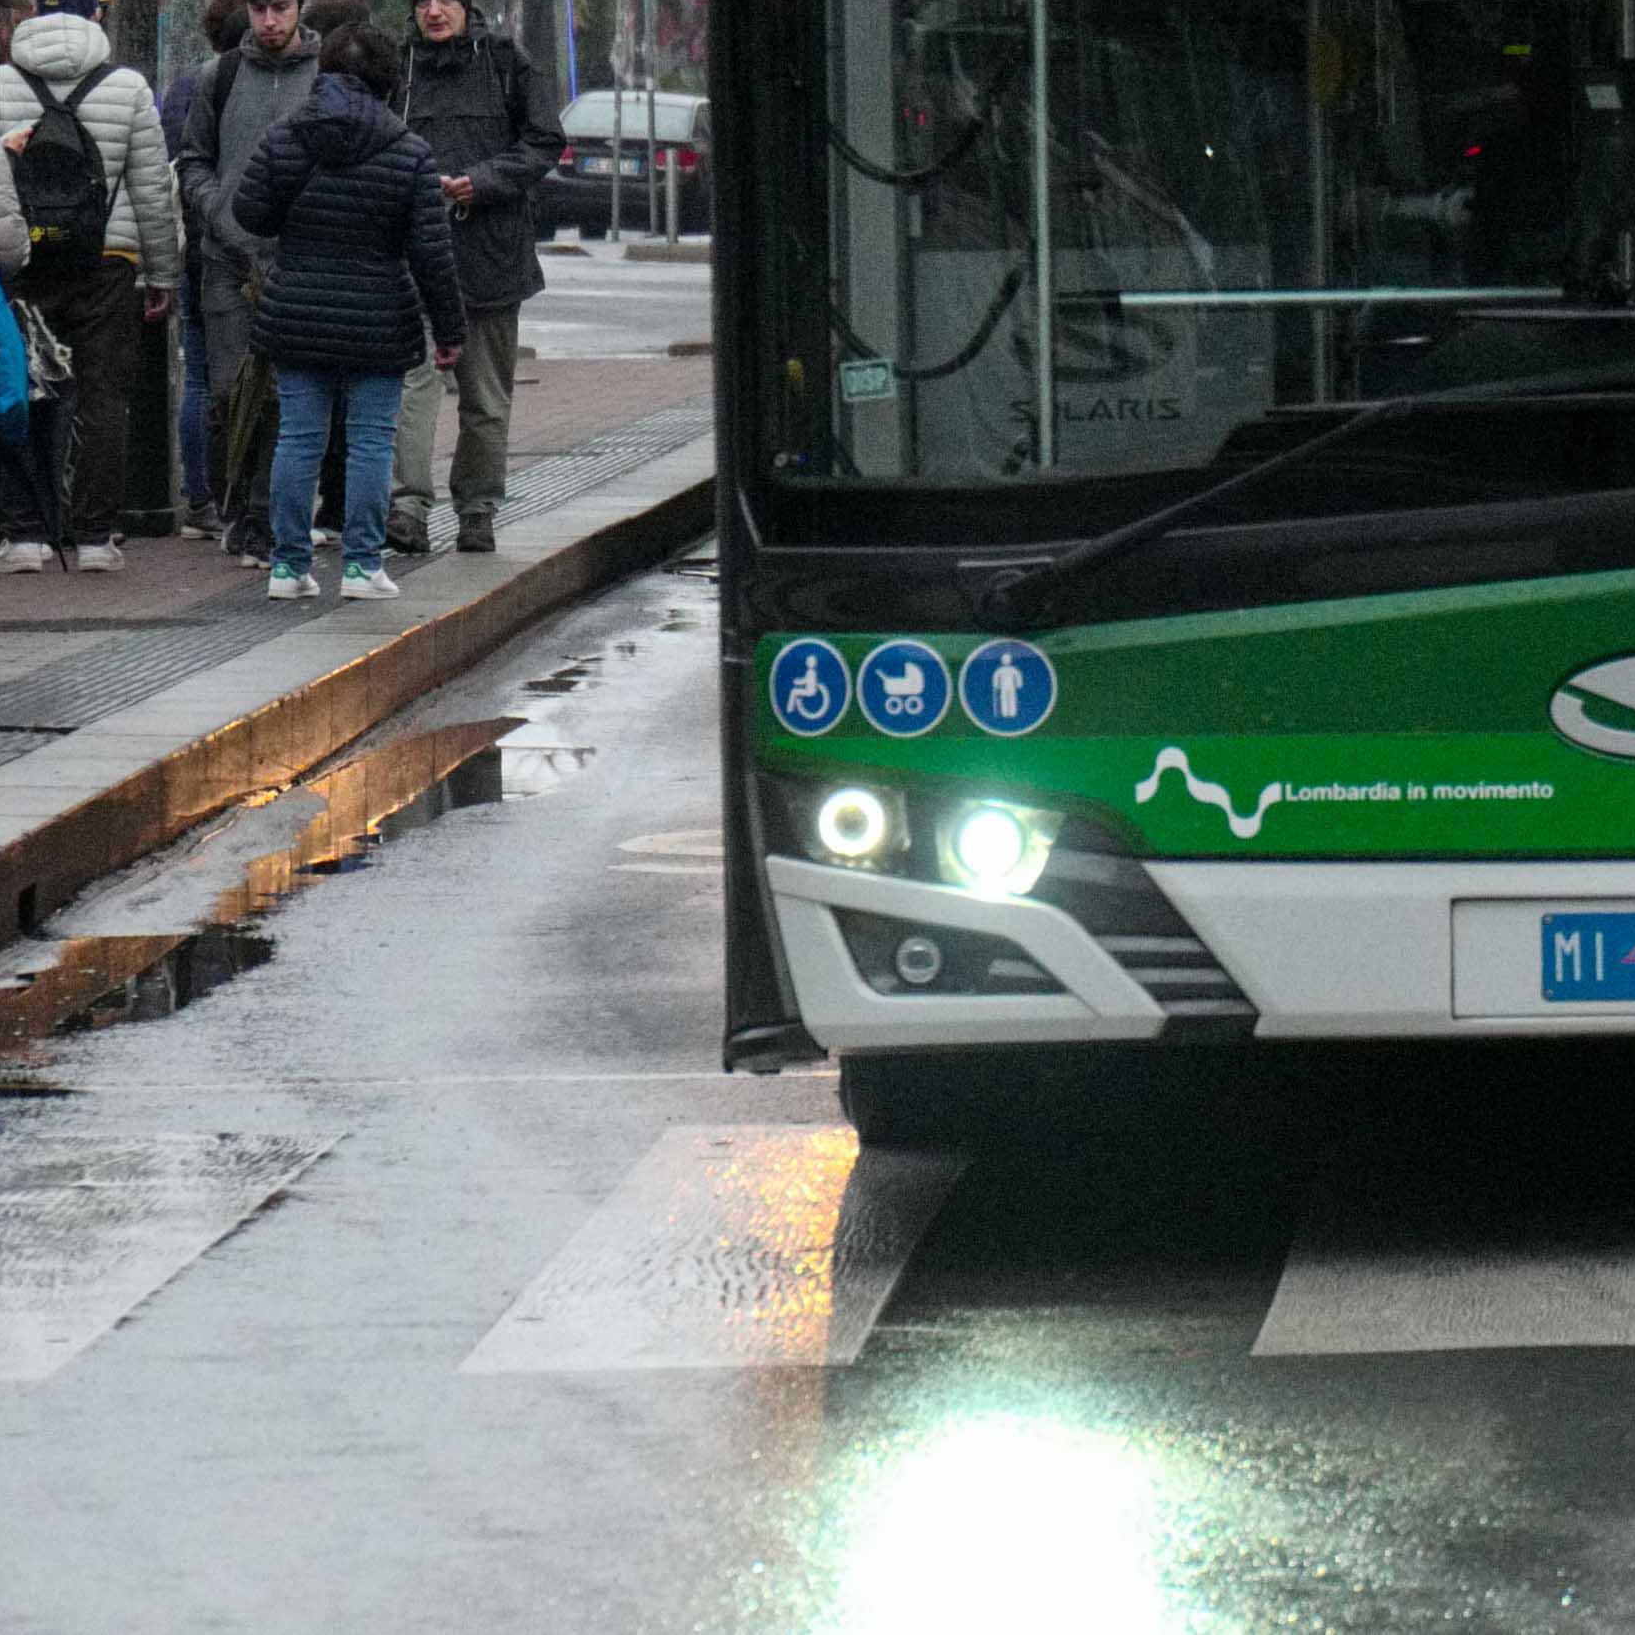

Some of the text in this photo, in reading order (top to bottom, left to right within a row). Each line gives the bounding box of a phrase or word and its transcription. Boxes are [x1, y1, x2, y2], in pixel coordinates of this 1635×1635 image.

[1010, 398, 1182, 421] SLARIS
[1285, 780, 1554, 802] Lombardia in movimento
[1555, 931, 1604, 982] MI
